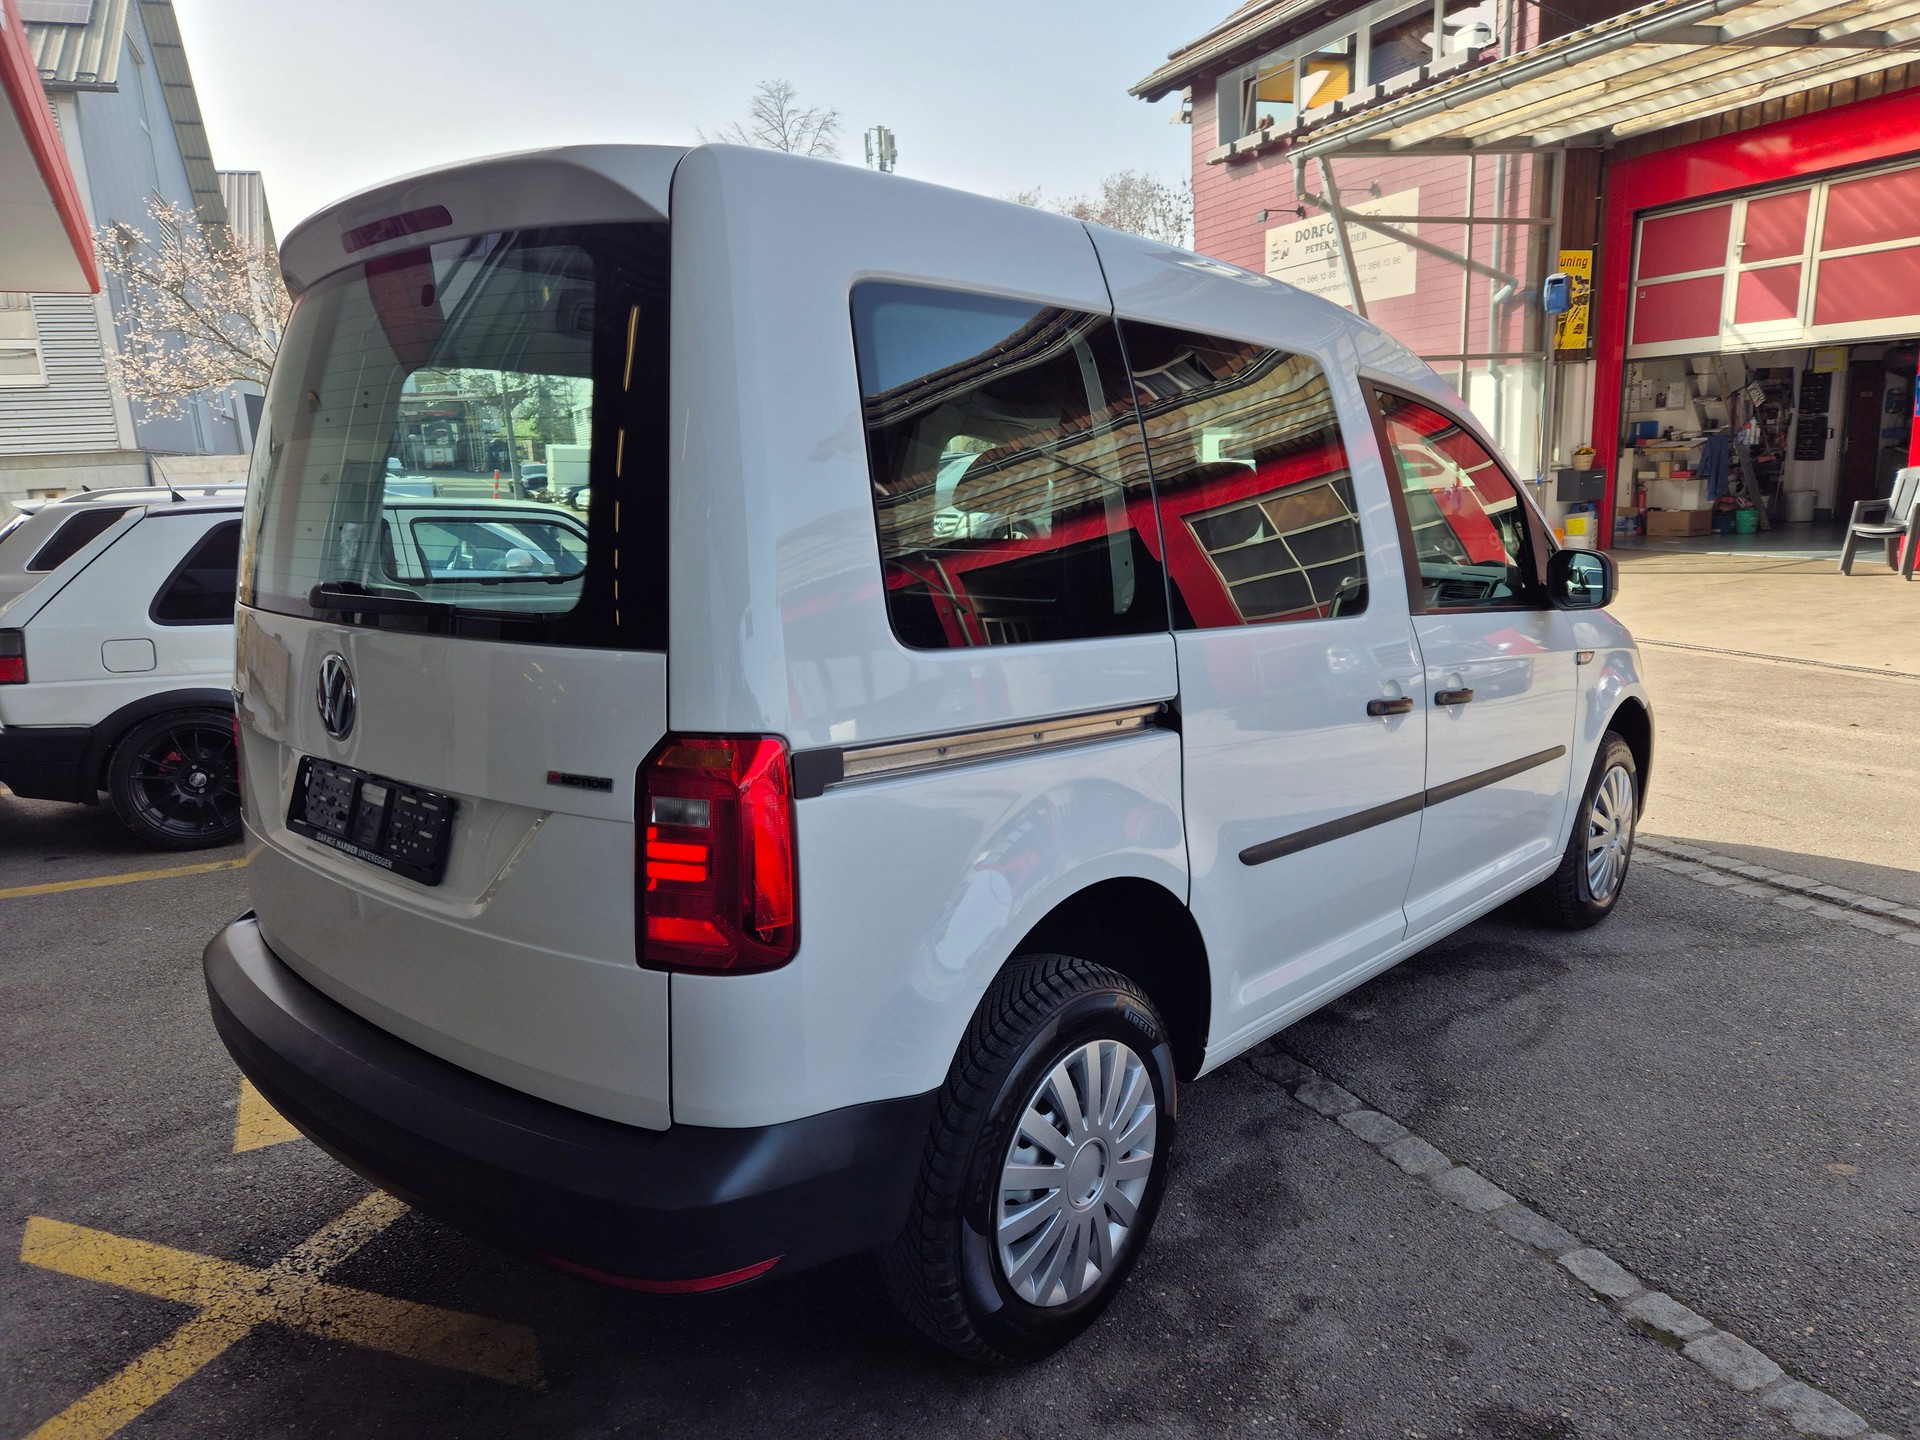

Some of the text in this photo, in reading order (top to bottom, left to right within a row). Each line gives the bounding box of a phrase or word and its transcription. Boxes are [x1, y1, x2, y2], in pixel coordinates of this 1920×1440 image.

[1305, 231, 1368, 254] PETER HDER
[1559, 256, 1588, 269] uning
[316, 832, 393, 869] GARAGE HARDER UNTEREGGEN
[1124, 1003, 1157, 1040] PIRELLI
